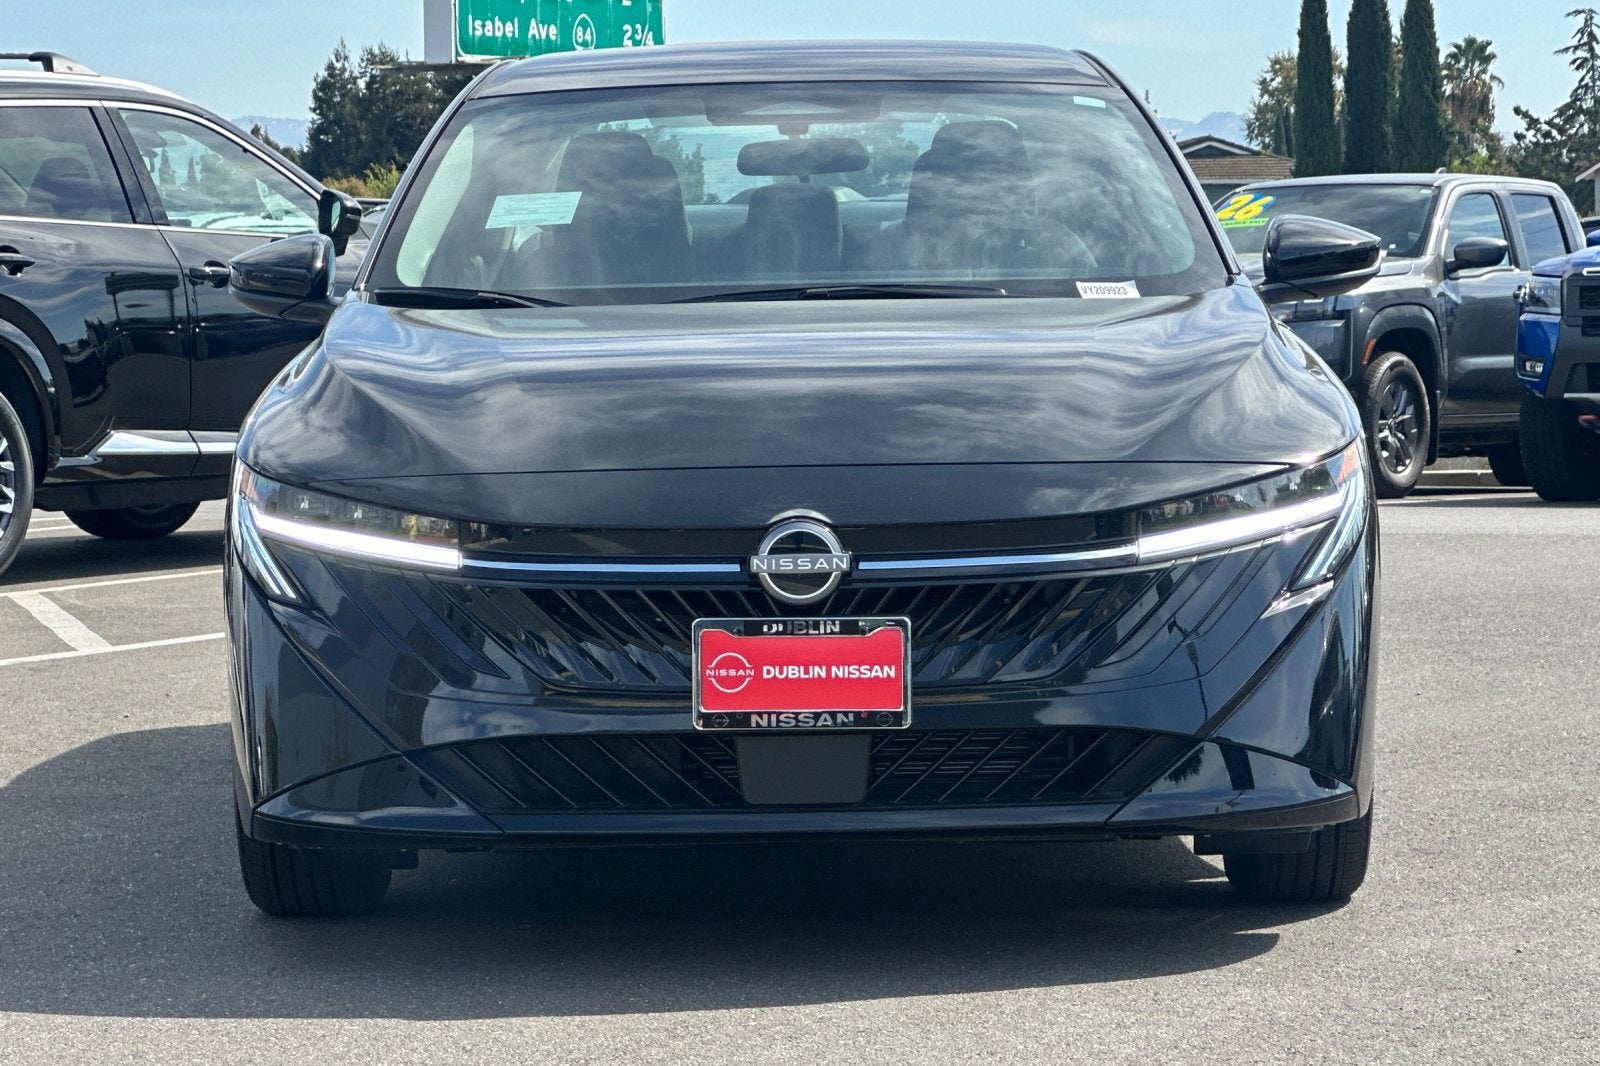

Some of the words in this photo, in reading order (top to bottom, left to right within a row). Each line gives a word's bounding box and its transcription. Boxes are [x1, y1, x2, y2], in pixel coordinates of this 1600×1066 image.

[468, 14, 519, 38] Isabel
[528, 17, 558, 40] Ave
[575, 26, 593, 43] 84
[1080, 285, 1128, 295] VY209923
[753, 557, 847, 571] NISSAN
[762, 620, 841, 635] DUBLIN
[706, 668, 755, 677] NISSAN
[762, 665, 826, 679] DUBLIN
[831, 664, 896, 679] NISSAN
[750, 712, 855, 728] NISSAN
